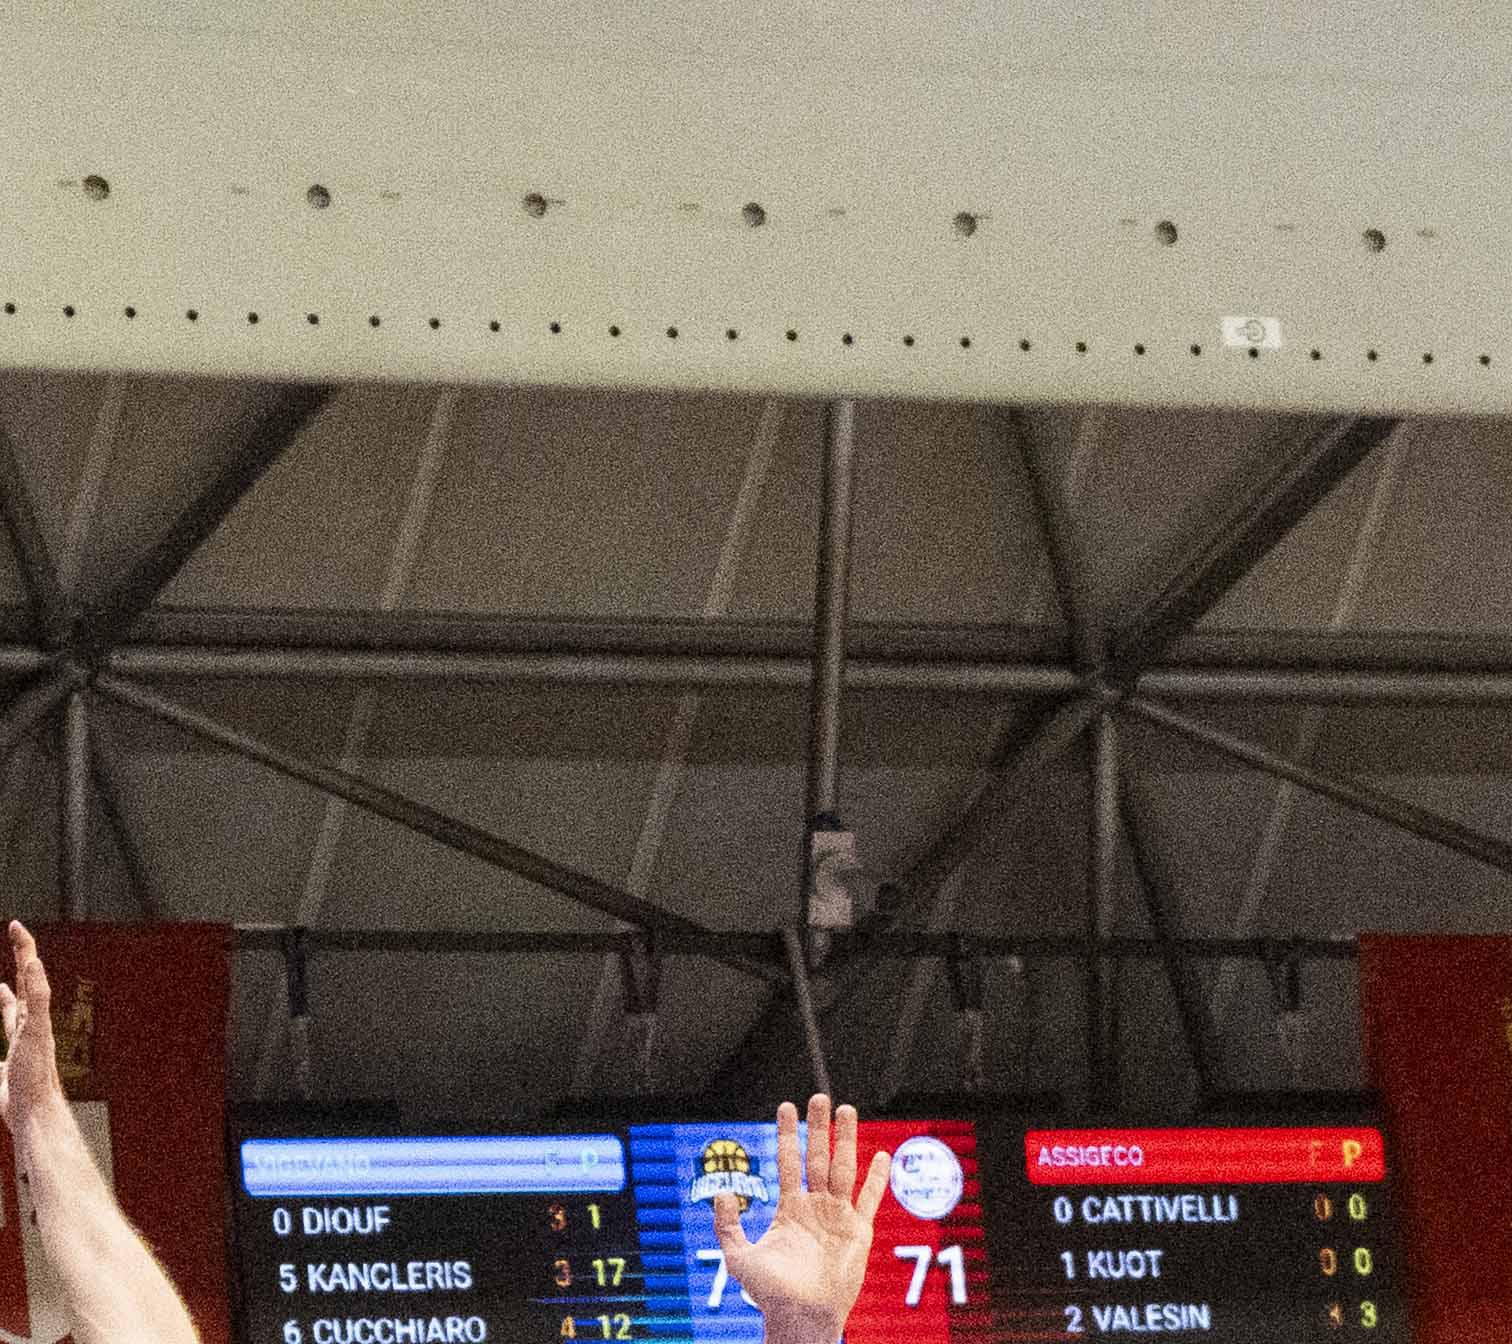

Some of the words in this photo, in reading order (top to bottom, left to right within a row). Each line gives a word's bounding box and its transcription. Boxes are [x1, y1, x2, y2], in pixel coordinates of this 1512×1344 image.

[1037, 1145, 1144, 1168] ASSIGECO
[1342, 1139, 1362, 1167] P
[273, 1207, 291, 1234] 0
[303, 1205, 390, 1234] DIOUF
[588, 1204, 601, 1229] 1
[1053, 1195, 1073, 1224] 0
[1081, 1194, 1240, 1223] CATTIVELLI
[1314, 1193, 1333, 1220] 0
[1348, 1193, 1367, 1220] 0
[280, 1264, 297, 1292] 5
[308, 1261, 472, 1292] KANCLERIS
[592, 1258, 626, 1286] 17
[894, 1245, 967, 1306] 71
[1060, 1251, 1076, 1278] 1
[1087, 1249, 1165, 1279] KUOT
[1319, 1247, 1337, 1276] 0
[1353, 1247, 1373, 1275] 0
[560, 1316, 576, 1339] 4
[597, 1314, 633, 1340] 12
[1064, 1305, 1085, 1333] 2
[1092, 1302, 1212, 1332] VALESIN
[1360, 1301, 1377, 1328] 3
